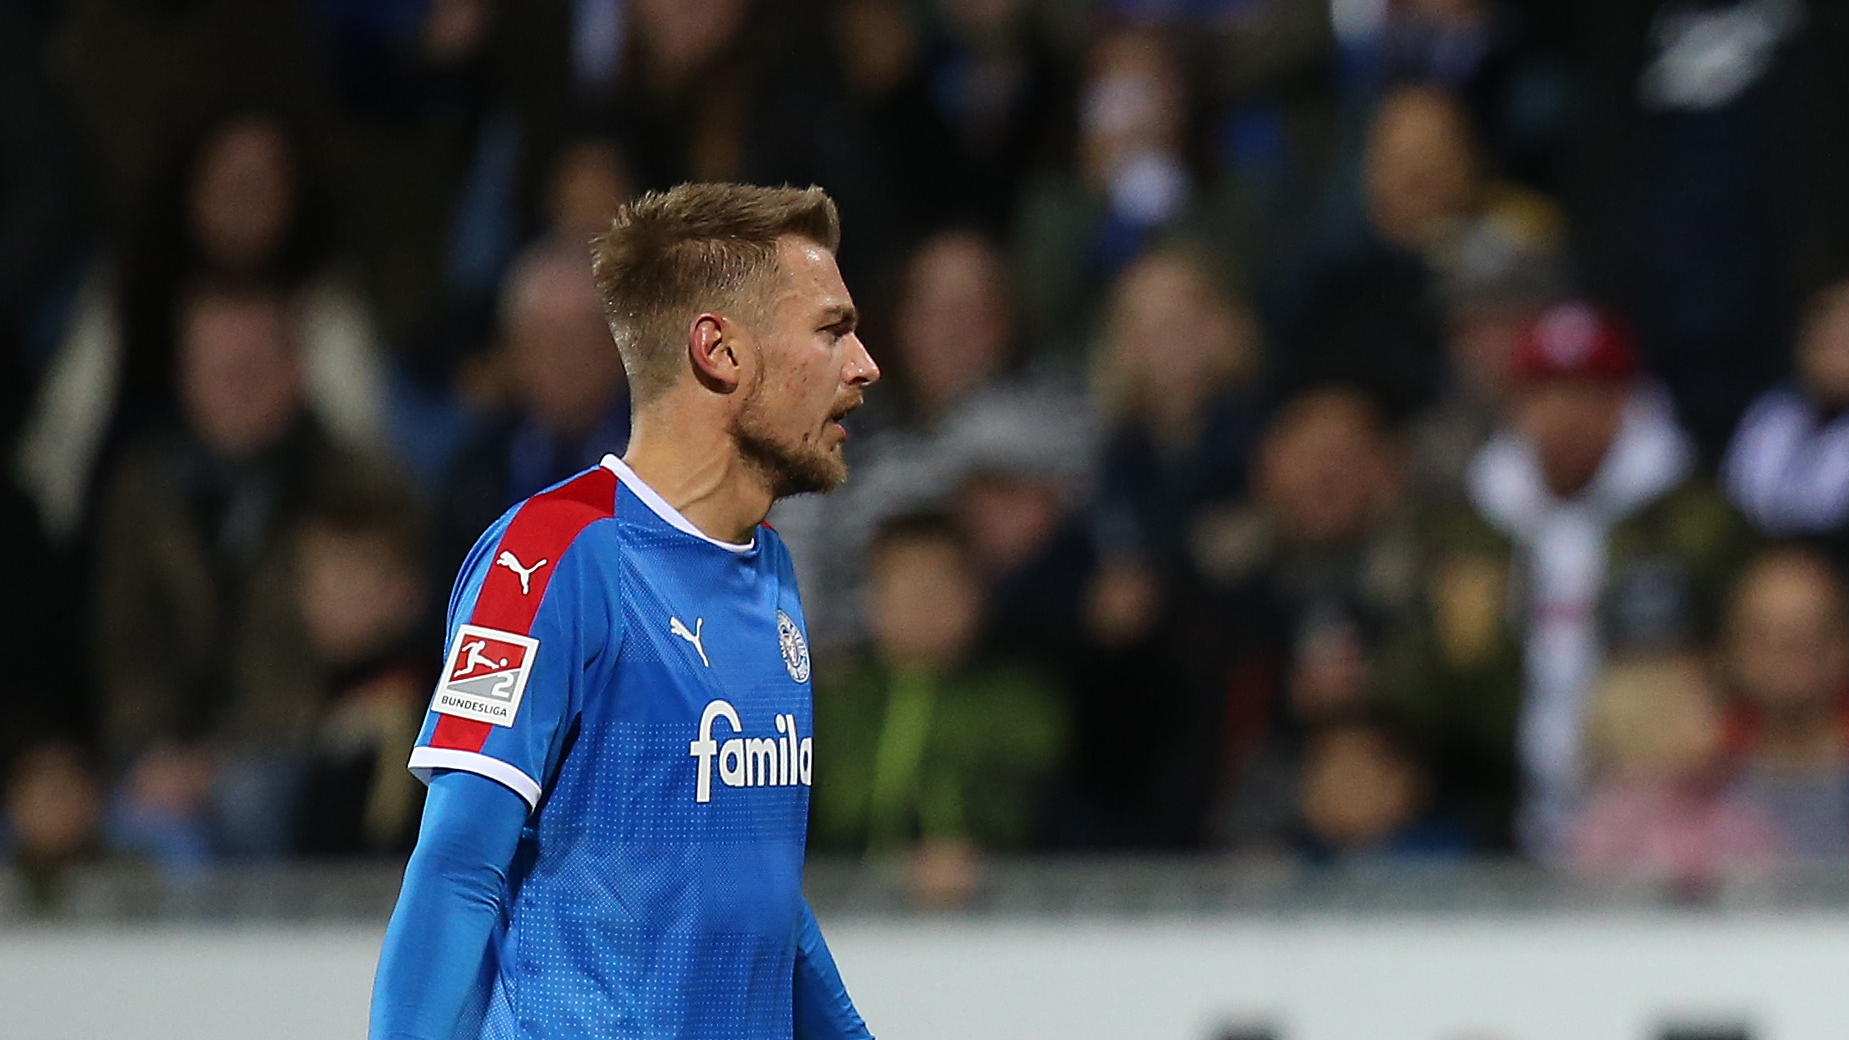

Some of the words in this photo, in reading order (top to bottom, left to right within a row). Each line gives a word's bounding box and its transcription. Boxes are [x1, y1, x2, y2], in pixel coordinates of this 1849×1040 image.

[491, 671, 515, 698] 2
[441, 695, 508, 718] BUNDESLIGA
[689, 699, 813, 803] famila
